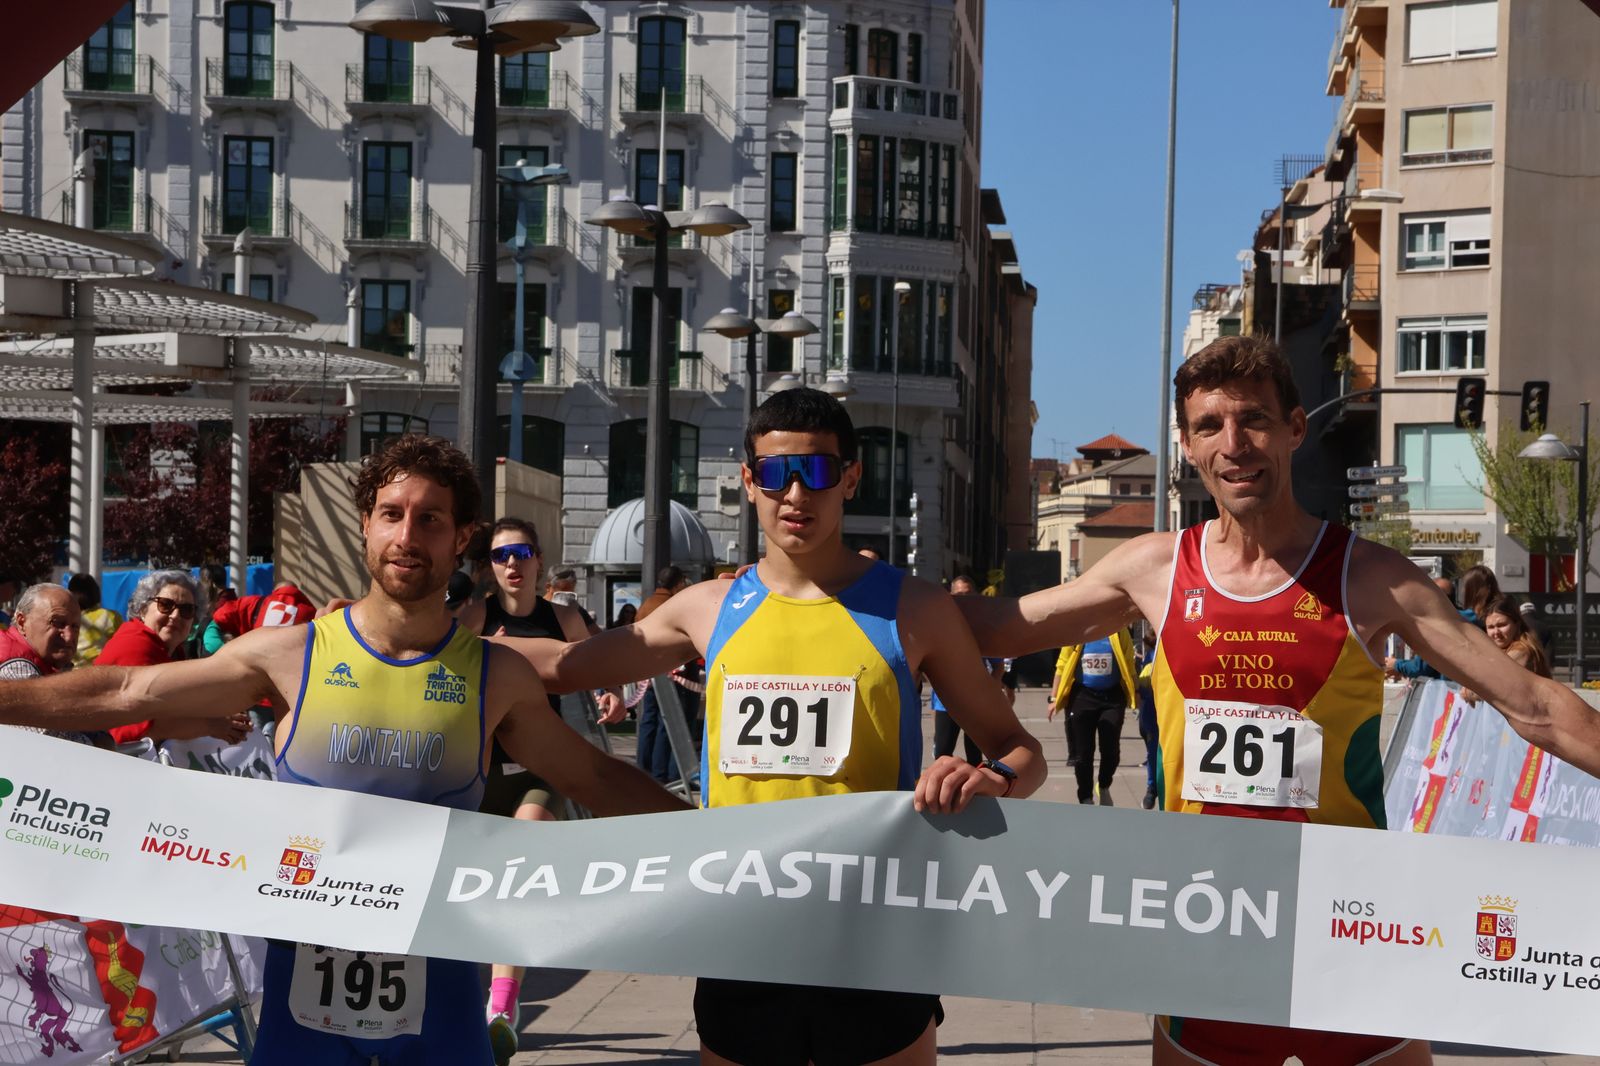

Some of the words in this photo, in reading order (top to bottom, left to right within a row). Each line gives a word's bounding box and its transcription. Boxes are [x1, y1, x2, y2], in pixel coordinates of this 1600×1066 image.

[1223, 631, 1255, 642] CAJA
[1257, 631, 1299, 643] RURAL
[1086, 658, 1108, 669] 525
[1216, 654, 1274, 670] VINO
[426, 680, 466, 692] TRIATLON
[727, 681, 746, 691] DÍA
[746, 681, 759, 691] DE
[761, 682, 811, 692] CASTILLA
[812, 683, 820, 691] Y
[821, 681, 851, 692] LEÓN
[1199, 674, 1227, 690] DE
[1231, 673, 1294, 690] TORO
[424, 690, 467, 705] DUERO
[736, 695, 830, 748] 291
[1188, 705, 1206, 716] DÍA
[1208, 708, 1222, 717] DE
[1224, 708, 1276, 720] CASTILLA
[1278, 711, 1286, 720] Y
[1288, 712, 1305, 722] LE
[328, 722, 446, 772] MONTALVO
[1199, 722, 1296, 779] 261
[1256, 785, 1275, 793] Plena
[16, 784, 111, 827] Plena
[9, 807, 103, 843] inclusión
[147, 821, 190, 840] NOS
[5, 828, 59, 851] Castilla
[61, 842, 72, 856] y
[73, 843, 110, 862] León
[317, 876, 374, 893] Junta
[379, 880, 405, 896] de
[446, 856, 561, 902] DÍA
[579, 855, 671, 896] DE
[688, 849, 1008, 916] CASTILLA
[1025, 868, 1070, 919] Y
[1088, 869, 1279, 939] LEÓN
[257, 883, 327, 904] Castilla
[332, 893, 343, 907] y
[350, 892, 400, 911] León
[1332, 899, 1375, 917] NOS
[1521, 946, 1584, 967] Junta
[314, 956, 407, 1012] 195
[1460, 962, 1538, 985] Castilla
[1542, 973, 1557, 991] y
[1563, 971, 1600, 991] Leó
